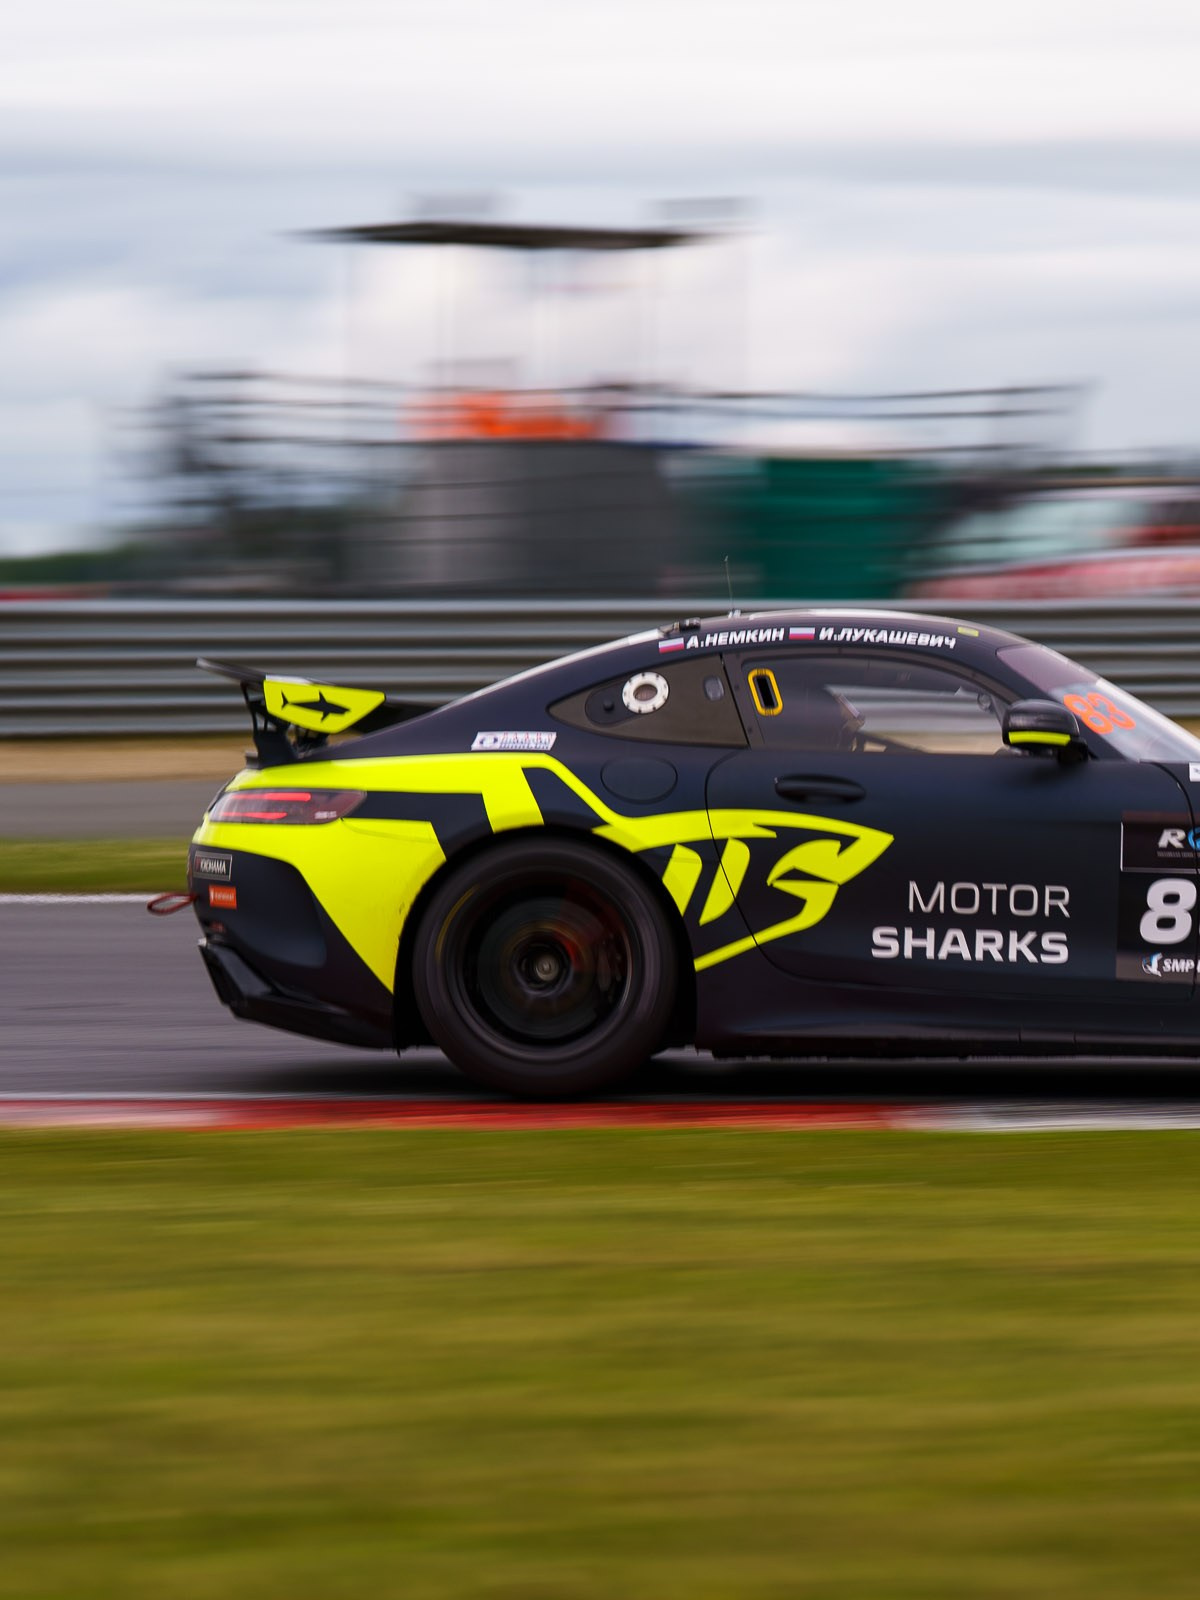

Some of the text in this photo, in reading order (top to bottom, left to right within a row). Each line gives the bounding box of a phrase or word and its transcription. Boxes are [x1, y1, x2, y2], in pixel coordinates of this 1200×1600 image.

[1063, 692, 1136, 734] 83
[908, 880, 1070, 918] MOTOR
[871, 926, 1070, 964] SHARKS
[1162, 958, 1195, 974] SMP
